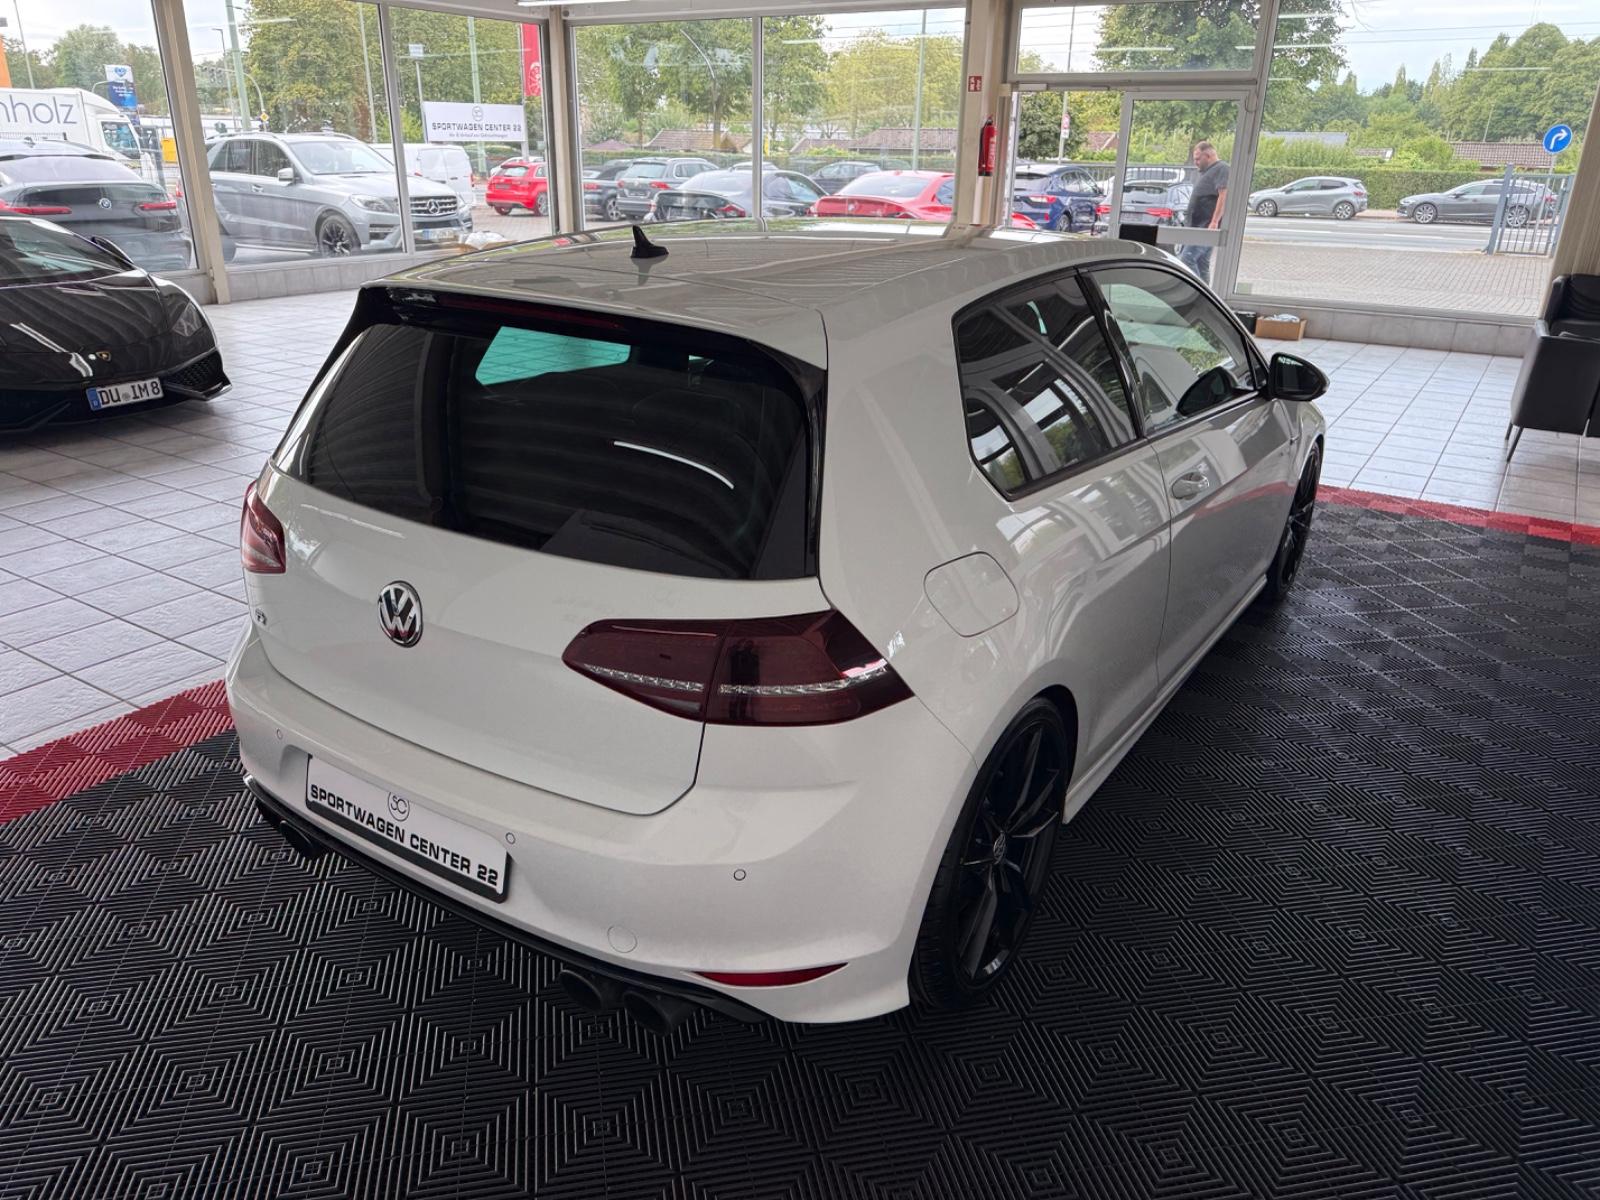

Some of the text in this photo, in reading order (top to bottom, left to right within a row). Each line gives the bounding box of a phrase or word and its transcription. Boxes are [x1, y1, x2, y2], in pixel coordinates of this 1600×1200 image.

[432, 122, 483, 131] SPORTWAGEN
[485, 123, 511, 132] CENTER
[98, 387, 122, 405] DU
[131, 383, 150, 400] IM
[151, 380, 160, 396] 8
[310, 784, 499, 887] SPORTWAGEN CENTER 22
